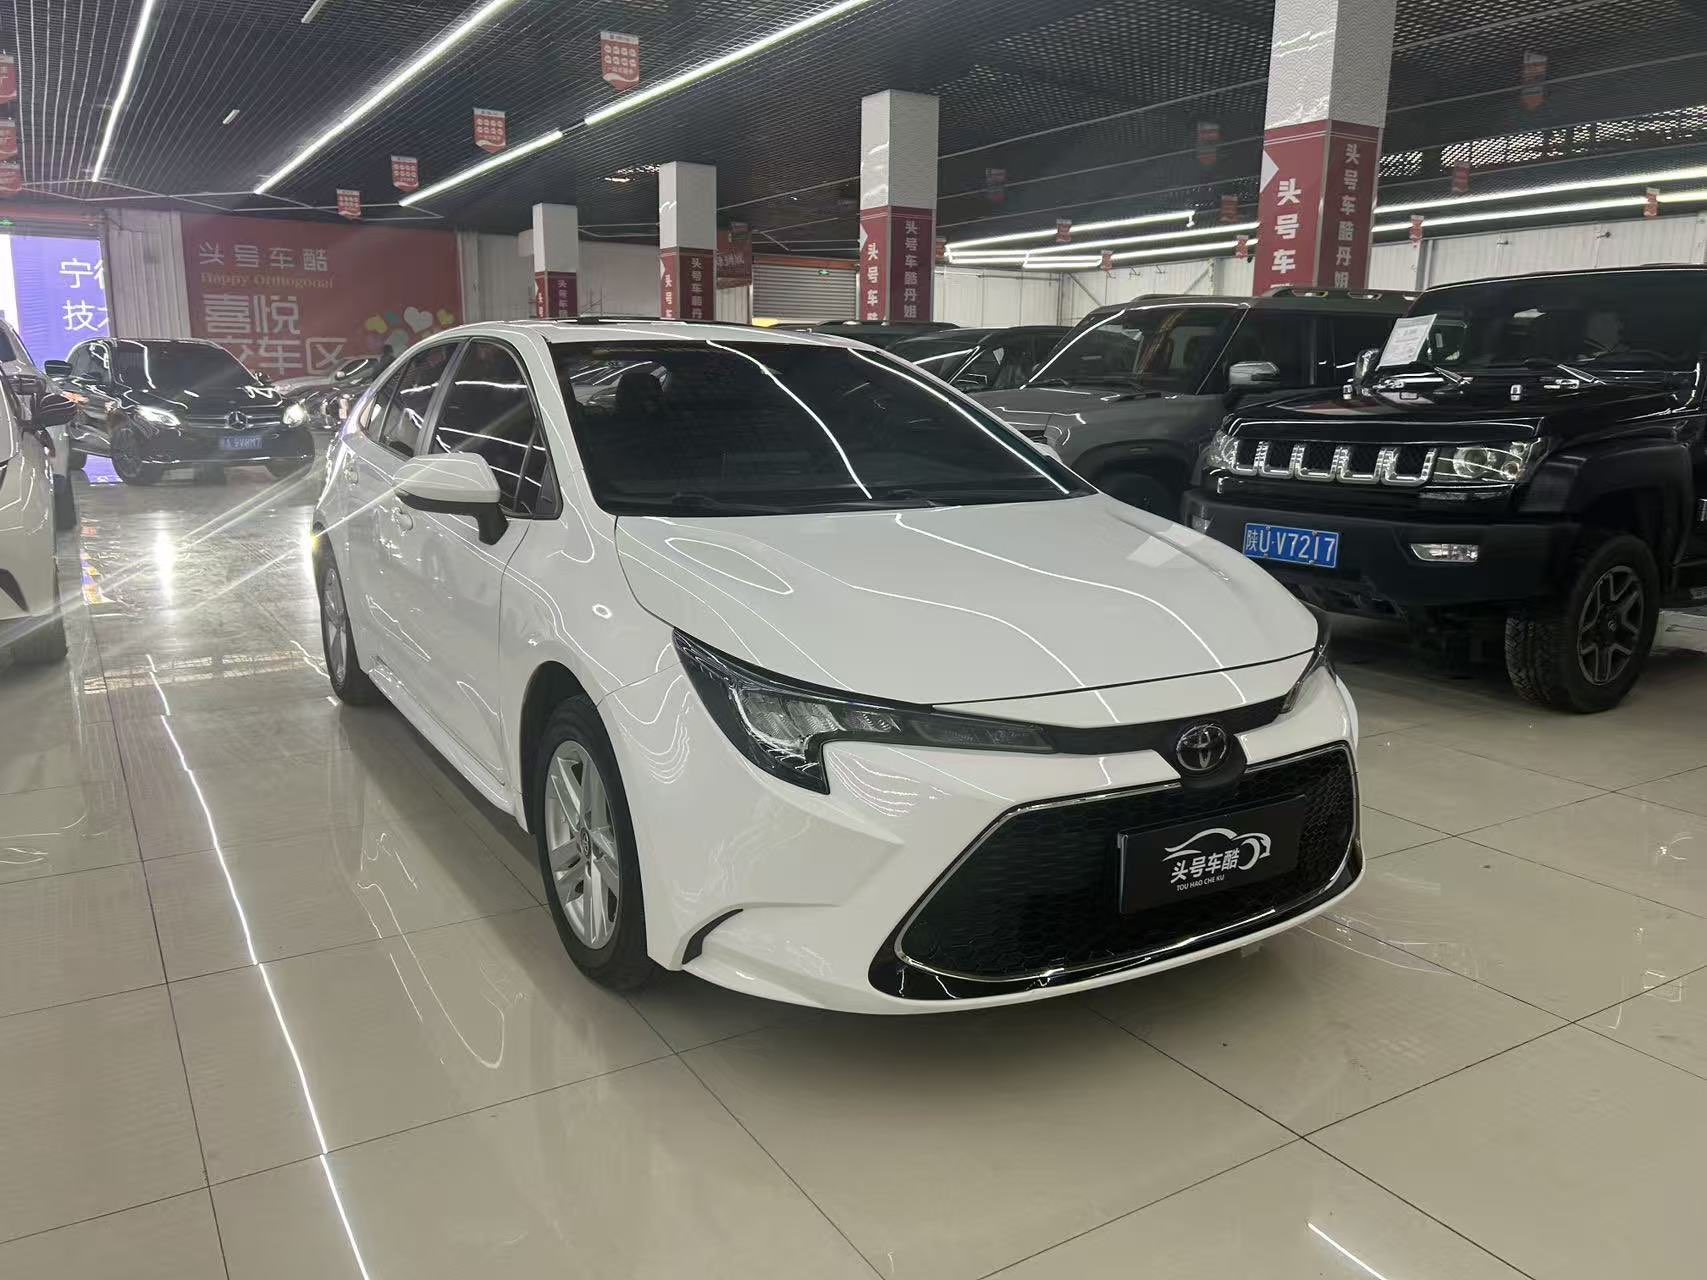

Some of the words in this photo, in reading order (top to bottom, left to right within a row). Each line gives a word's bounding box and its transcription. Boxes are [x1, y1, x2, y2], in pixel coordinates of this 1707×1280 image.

[1270, 178, 1302, 288] 头号车
[199, 241, 328, 272] 头号车酷
[200, 271, 250, 288] Happy
[202, 293, 301, 335] 喜悦
[1170, 847, 1240, 884] 头号车酷
[1176, 882, 1189, 891] TOU
[1190, 879, 1203, 888] HAO
[1204, 876, 1215, 885] CHE
[1216, 873, 1225, 881] KU
